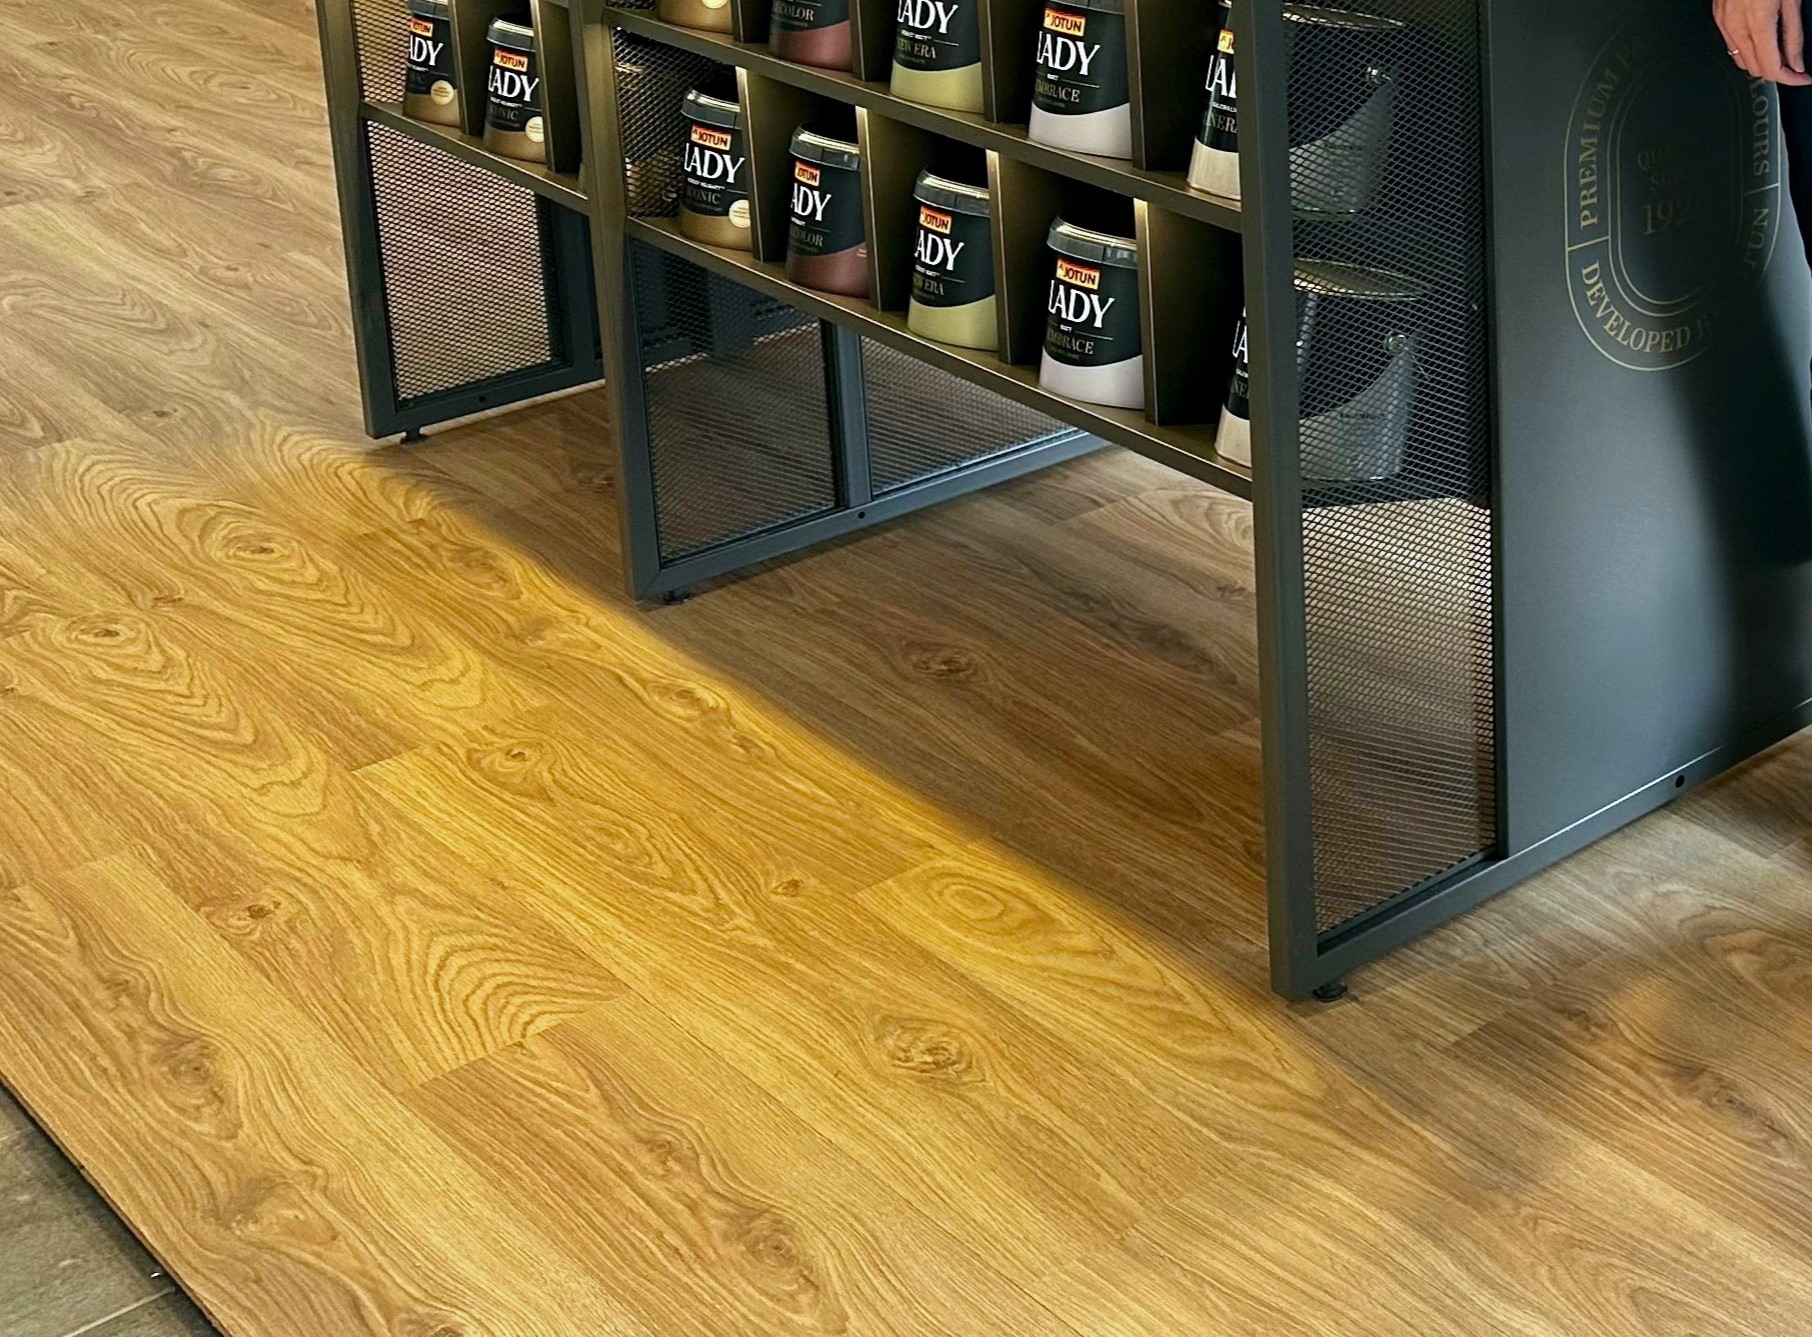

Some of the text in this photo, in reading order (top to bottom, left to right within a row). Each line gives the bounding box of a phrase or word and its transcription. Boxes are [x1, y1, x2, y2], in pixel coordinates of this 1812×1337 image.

[1050, 13, 1082, 34] JOTUN
[500, 53, 526, 69] JOTUN
[1036, 30, 1101, 76] LADY
[1204, 54, 1237, 98] LA
[699, 131, 729, 148] JOTUN
[1579, 66, 1619, 231] PREMIUM
[684, 142, 745, 184] LADY
[790, 182, 832, 222] ADY
[923, 211, 949, 231] JOTUN
[914, 226, 964, 271] ADY
[1063, 264, 1097, 287] JOTUN
[1048, 280, 1115, 329] LADY
[1581, 258, 1692, 354] DEVELOPED
